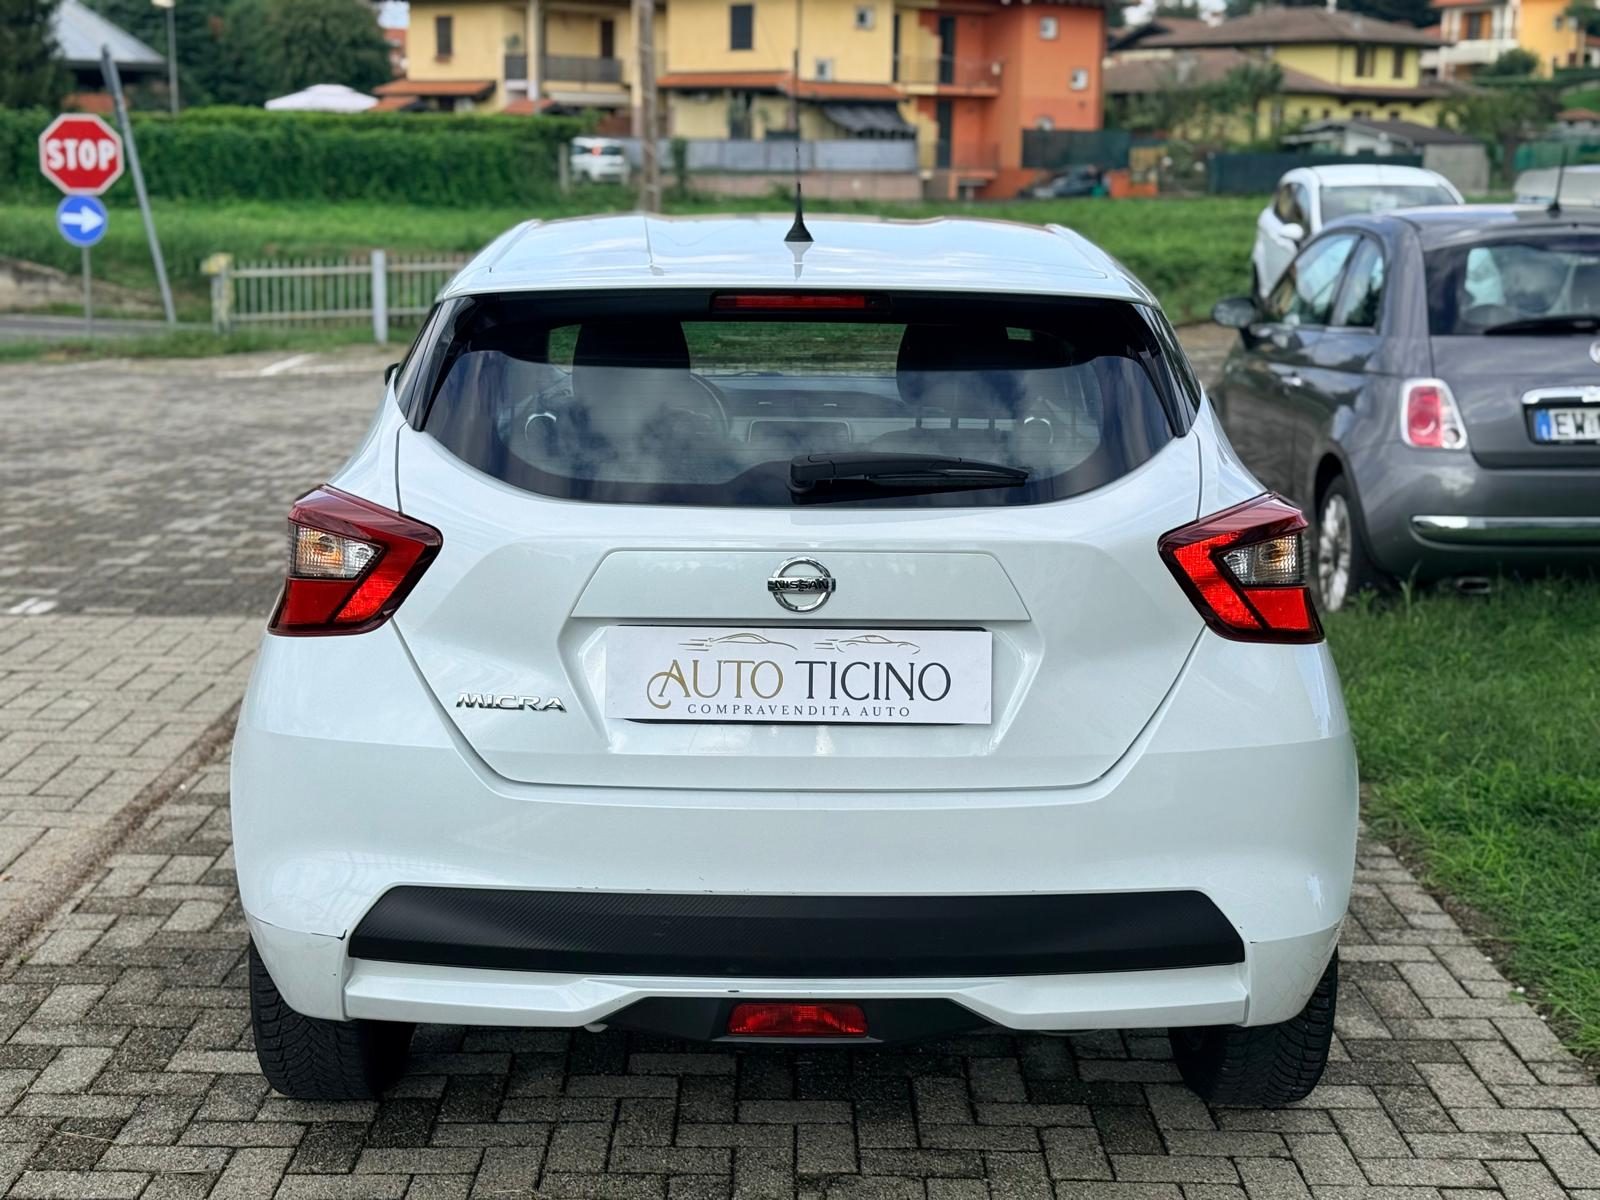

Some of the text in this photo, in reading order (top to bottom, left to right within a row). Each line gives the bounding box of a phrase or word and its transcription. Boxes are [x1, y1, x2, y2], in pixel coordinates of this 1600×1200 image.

[47, 139, 116, 171] STOP
[1554, 412, 1600, 436] EW
[774, 579, 829, 590] NISSAN
[646, 659, 952, 709] AUTO TICINO
[456, 692, 567, 713] MICRA
[687, 703, 910, 718] COMPRAVENDITA AUTO
